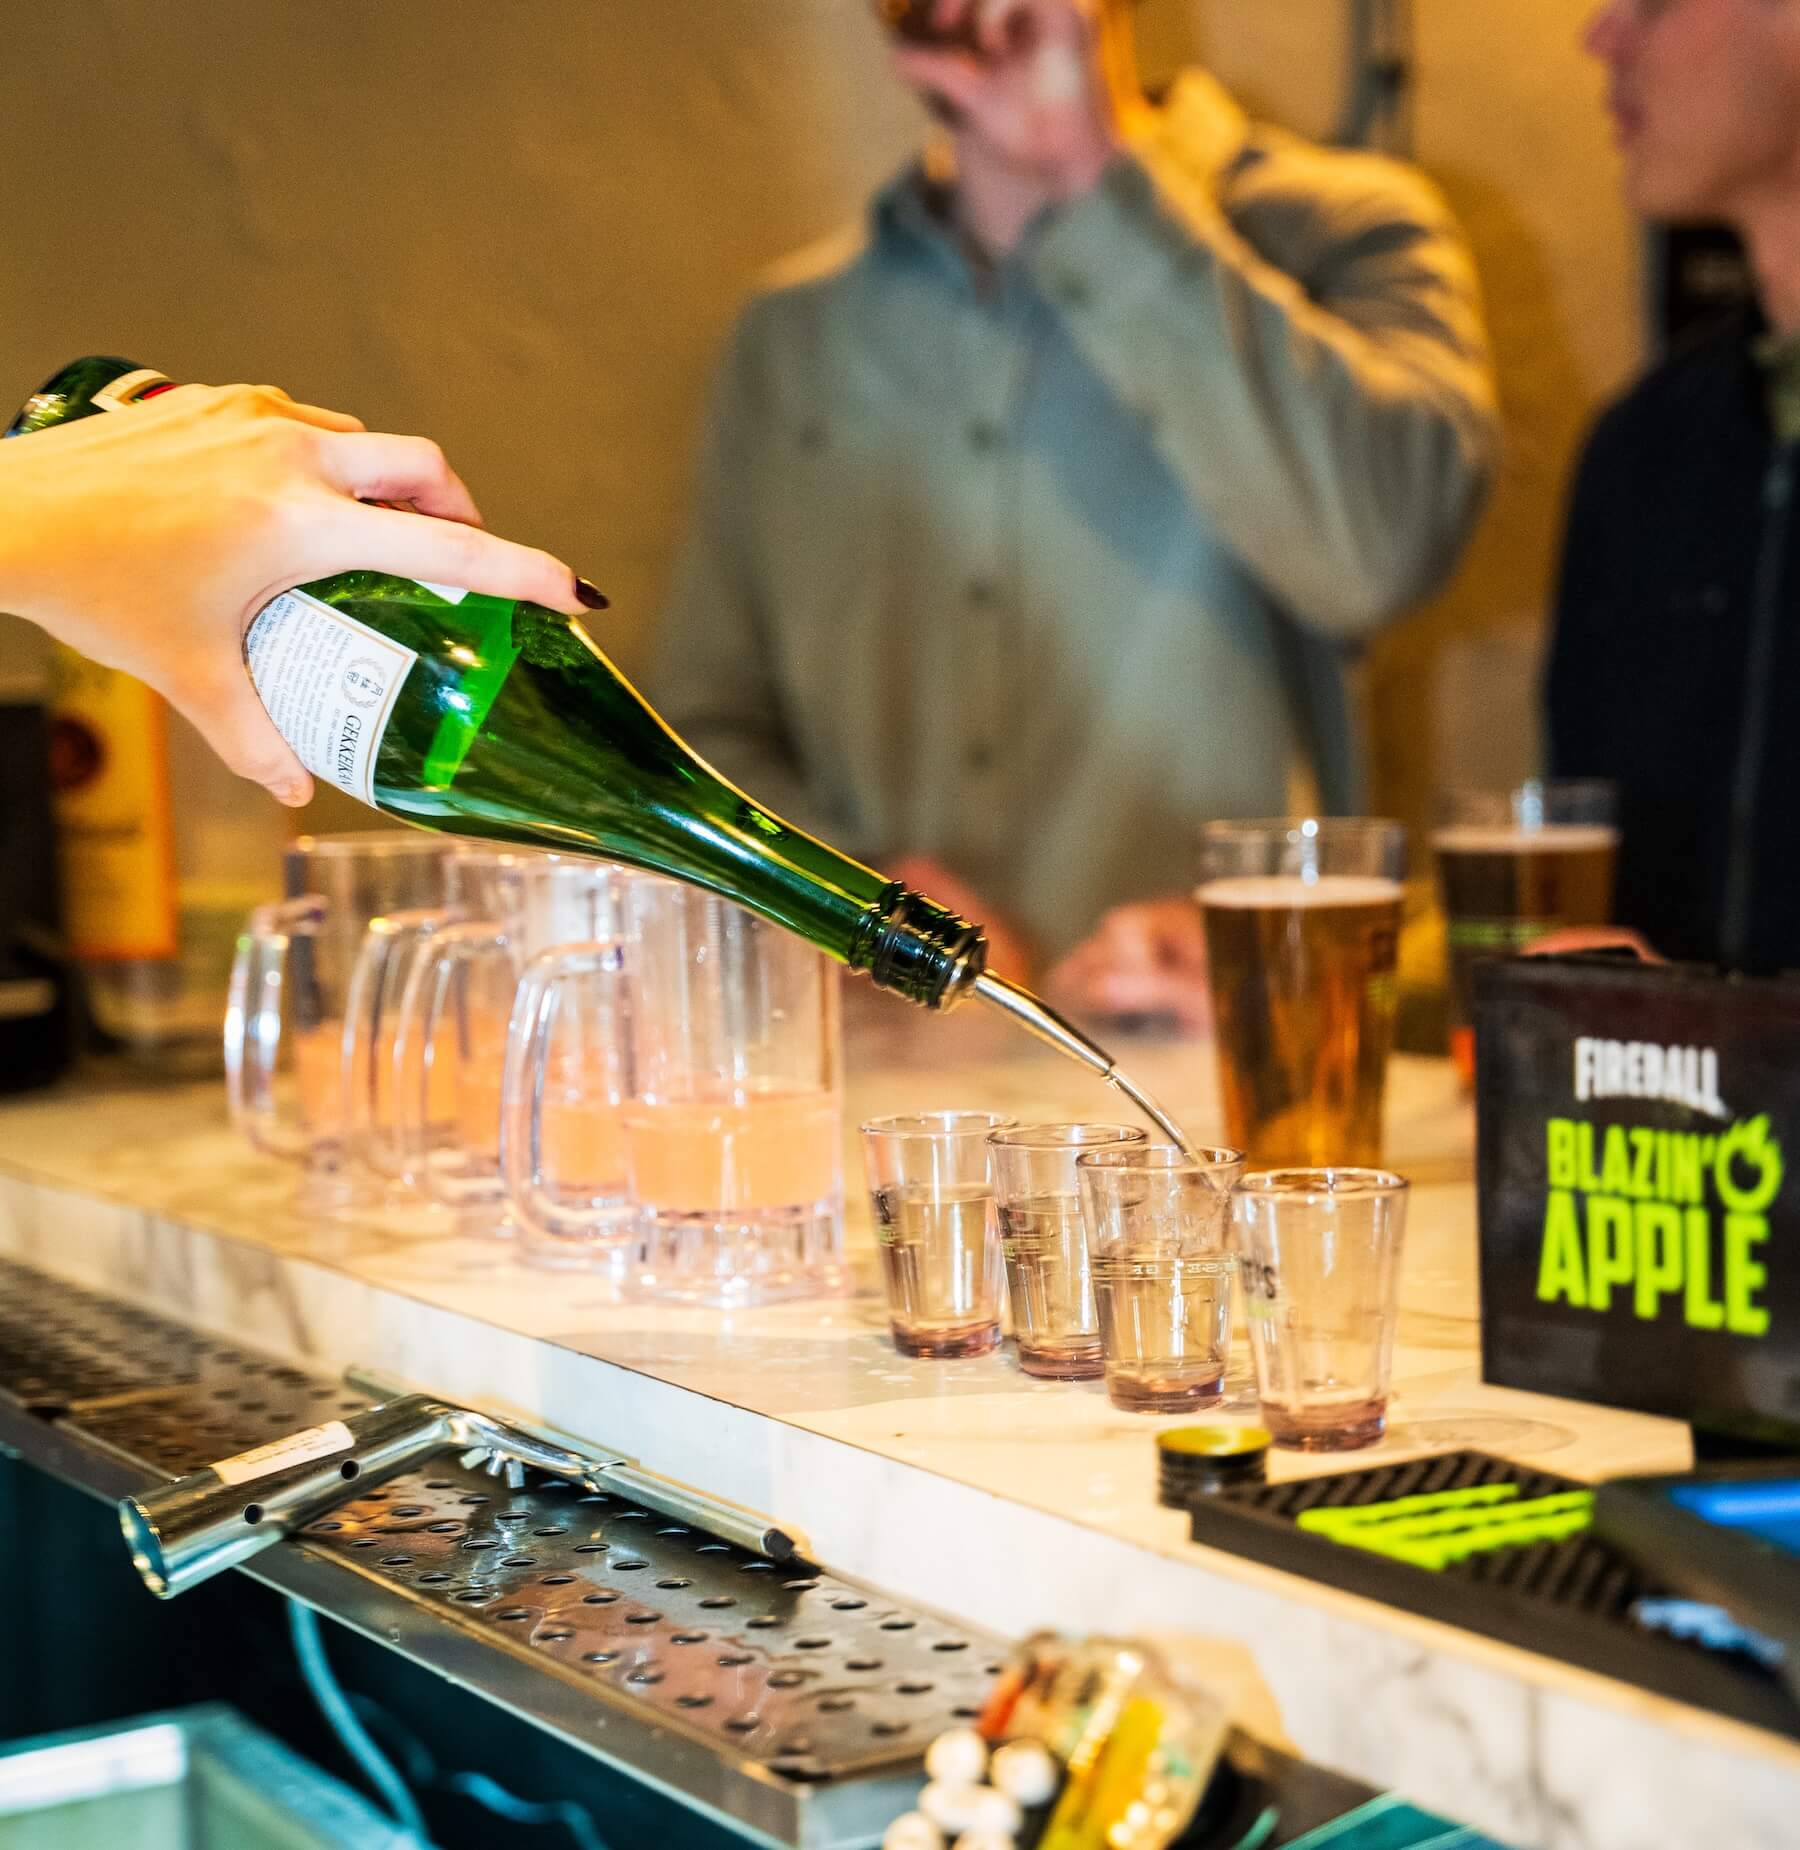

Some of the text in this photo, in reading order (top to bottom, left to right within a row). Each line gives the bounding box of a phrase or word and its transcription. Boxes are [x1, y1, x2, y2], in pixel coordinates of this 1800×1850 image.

[338, 714, 362, 786] GEKKEIKAN
[1575, 1037, 1729, 1118] FIREBALL
[1547, 1118, 1718, 1206] BLAZIN'
[1537, 1190, 1771, 1337] APPLE
